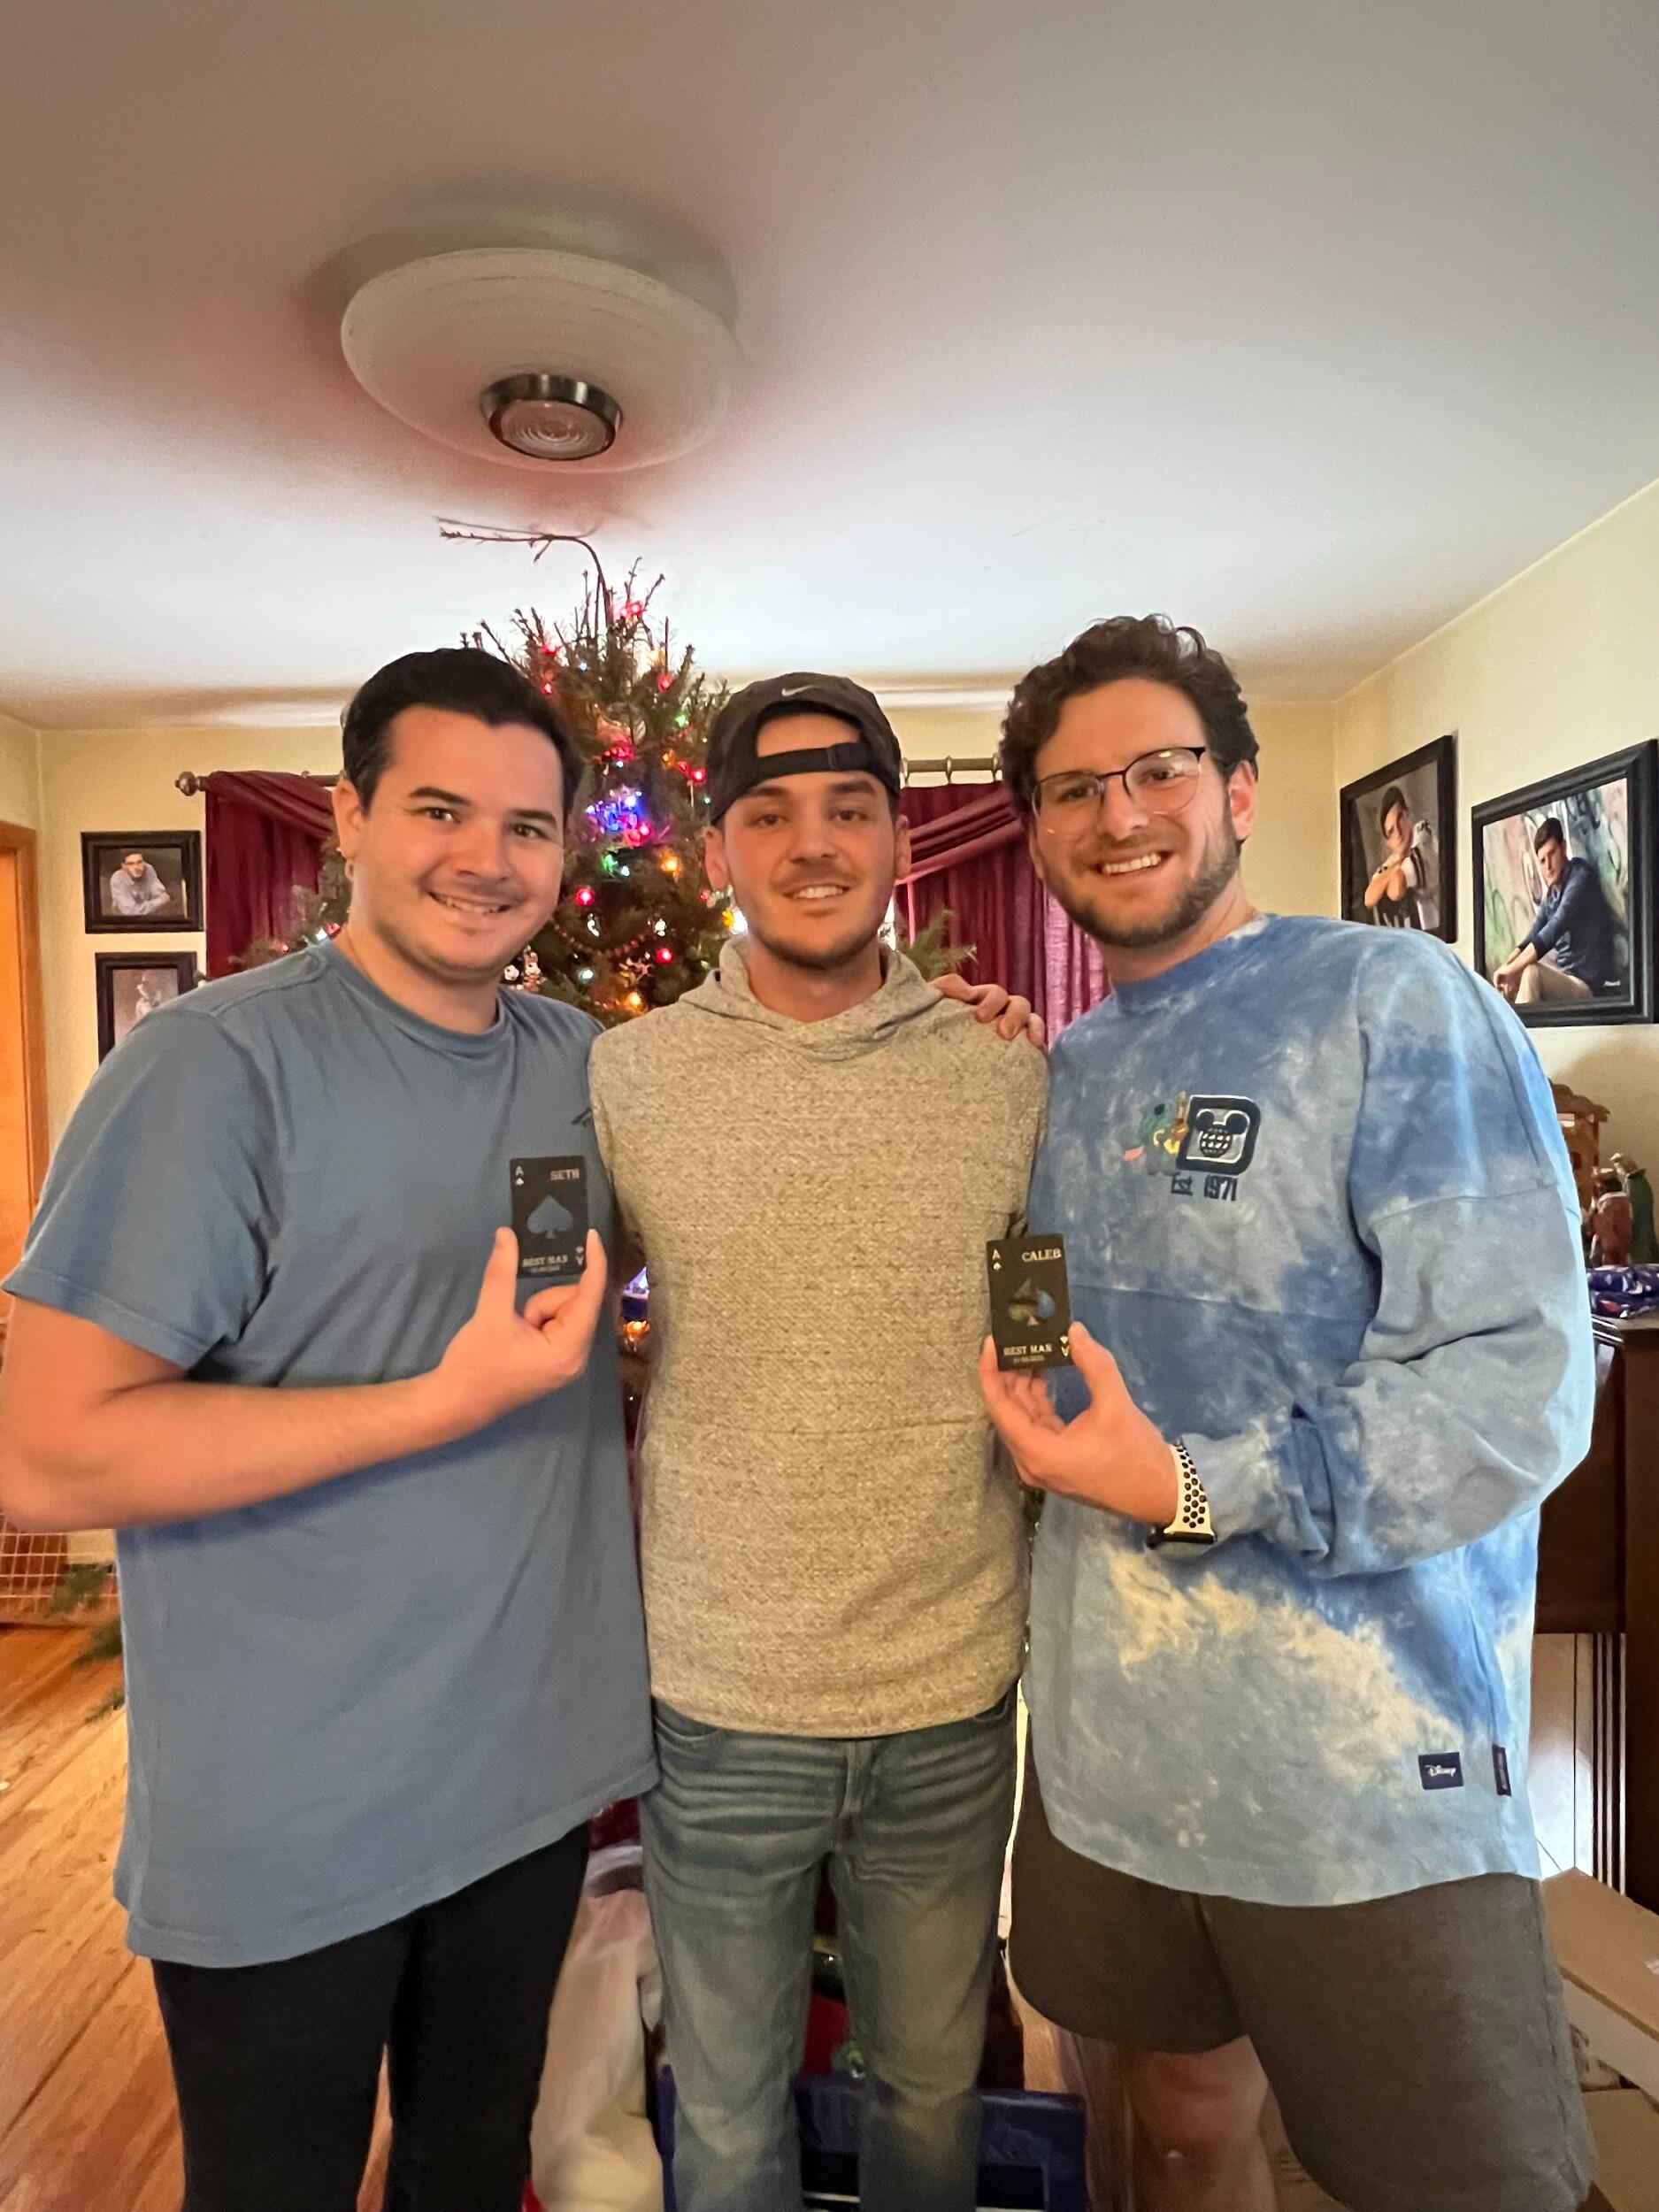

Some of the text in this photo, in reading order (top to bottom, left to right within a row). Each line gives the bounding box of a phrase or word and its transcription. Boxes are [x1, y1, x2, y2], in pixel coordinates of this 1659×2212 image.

[550, 1169, 580, 1180] SETH
[1204, 1175, 1237, 1201] 1971
[992, 1249, 1001, 1260] A
[1022, 1248, 1062, 1262] CALEB
[523, 1257, 545, 1267] BEST
[1003, 1344, 1052, 1356] BEST MAN
